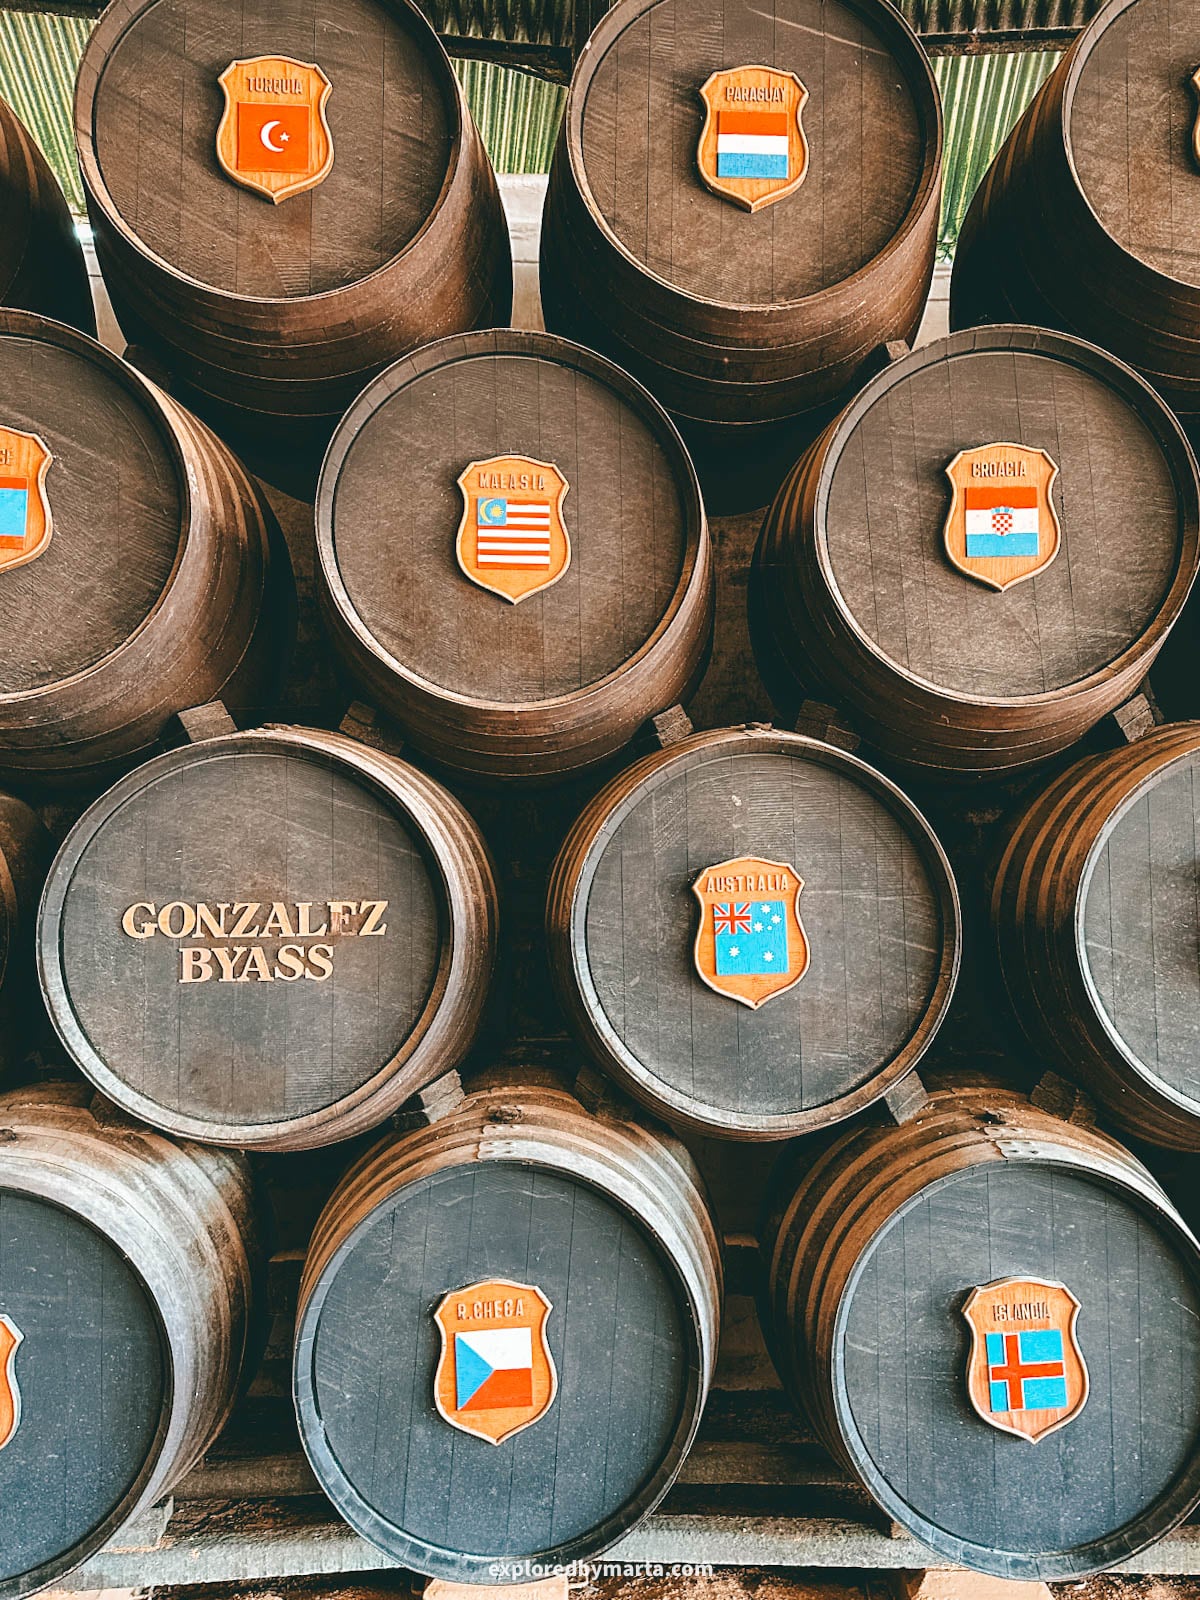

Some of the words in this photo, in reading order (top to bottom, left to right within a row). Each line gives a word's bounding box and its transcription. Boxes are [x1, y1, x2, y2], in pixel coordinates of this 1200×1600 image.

[246, 76, 303, 95] TURQUIA
[725, 86, 786, 103] PARAGUAY
[971, 460, 1028, 478] CROACIA
[478, 472, 545, 491] MALASIA
[705, 873, 789, 894] AUSTRALIA
[121, 900, 389, 940] GONZALEZ
[178, 943, 335, 984] BYASS
[456, 1298, 525, 1321] R.CHECA
[992, 1302, 1052, 1322] ISLANDIA
